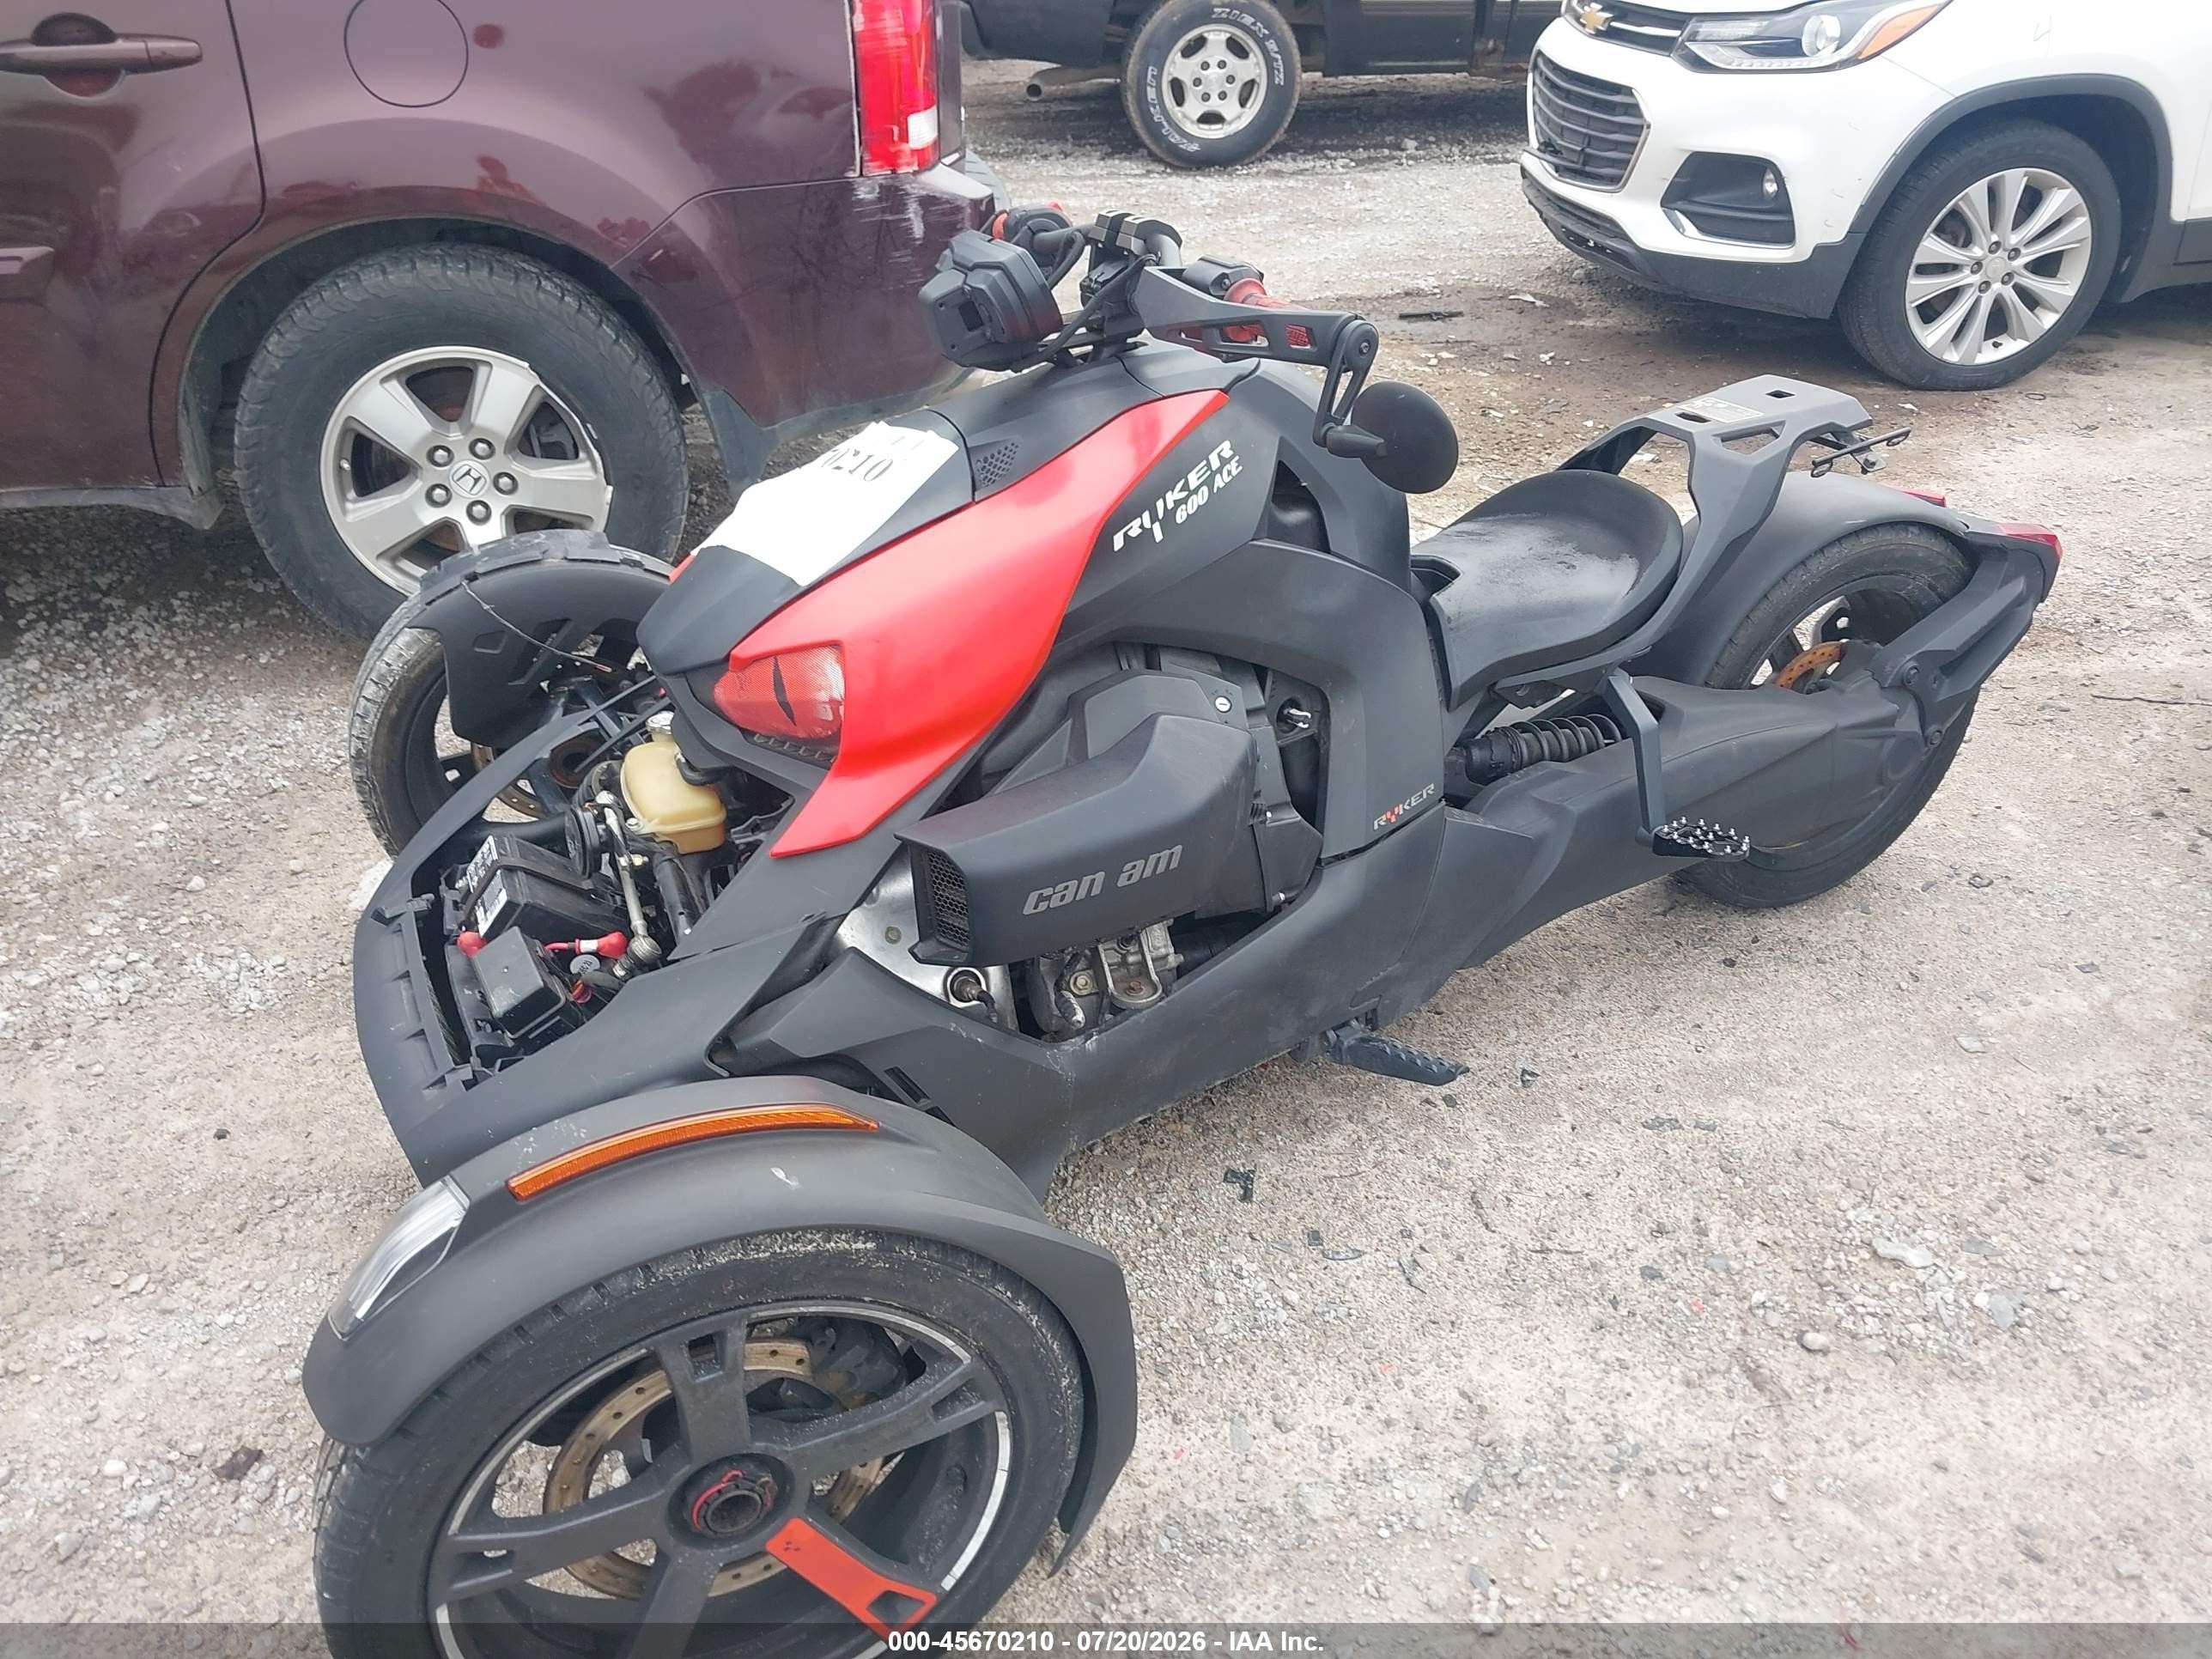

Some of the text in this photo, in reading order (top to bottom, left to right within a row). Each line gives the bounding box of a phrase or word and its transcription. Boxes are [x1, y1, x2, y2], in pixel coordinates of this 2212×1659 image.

[1212, 7, 1270, 38] ZIEX
[1146, 65, 1201, 152] FALKEN
[1113, 440, 1234, 552] RYKER
[1176, 455, 1243, 524] 600 ACE
[1373, 782, 1436, 830] RYKER
[1022, 844, 1183, 915] can am
